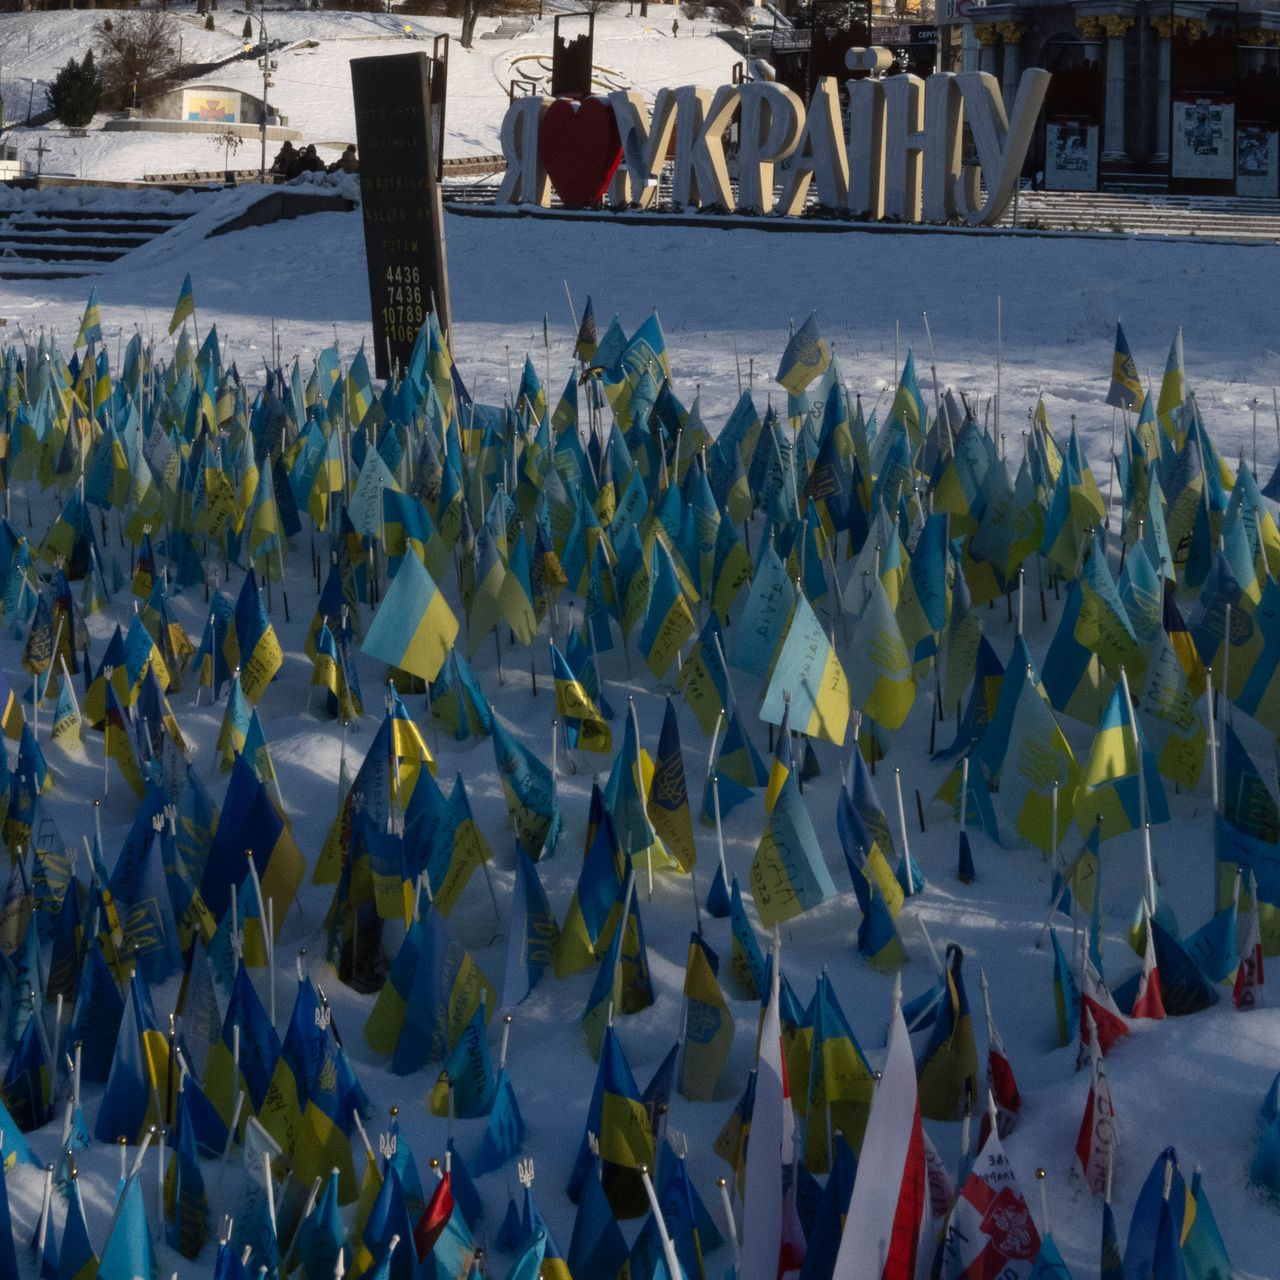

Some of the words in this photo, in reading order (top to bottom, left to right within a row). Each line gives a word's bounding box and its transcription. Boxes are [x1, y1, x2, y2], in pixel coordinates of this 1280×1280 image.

[495, 96, 553, 207] Я
[610, 44, 1051, 225] УКРАЇНУ
[386, 265, 420, 284] 4436
[387, 286, 422, 305] 7436
[383, 305, 423, 324] 10789
